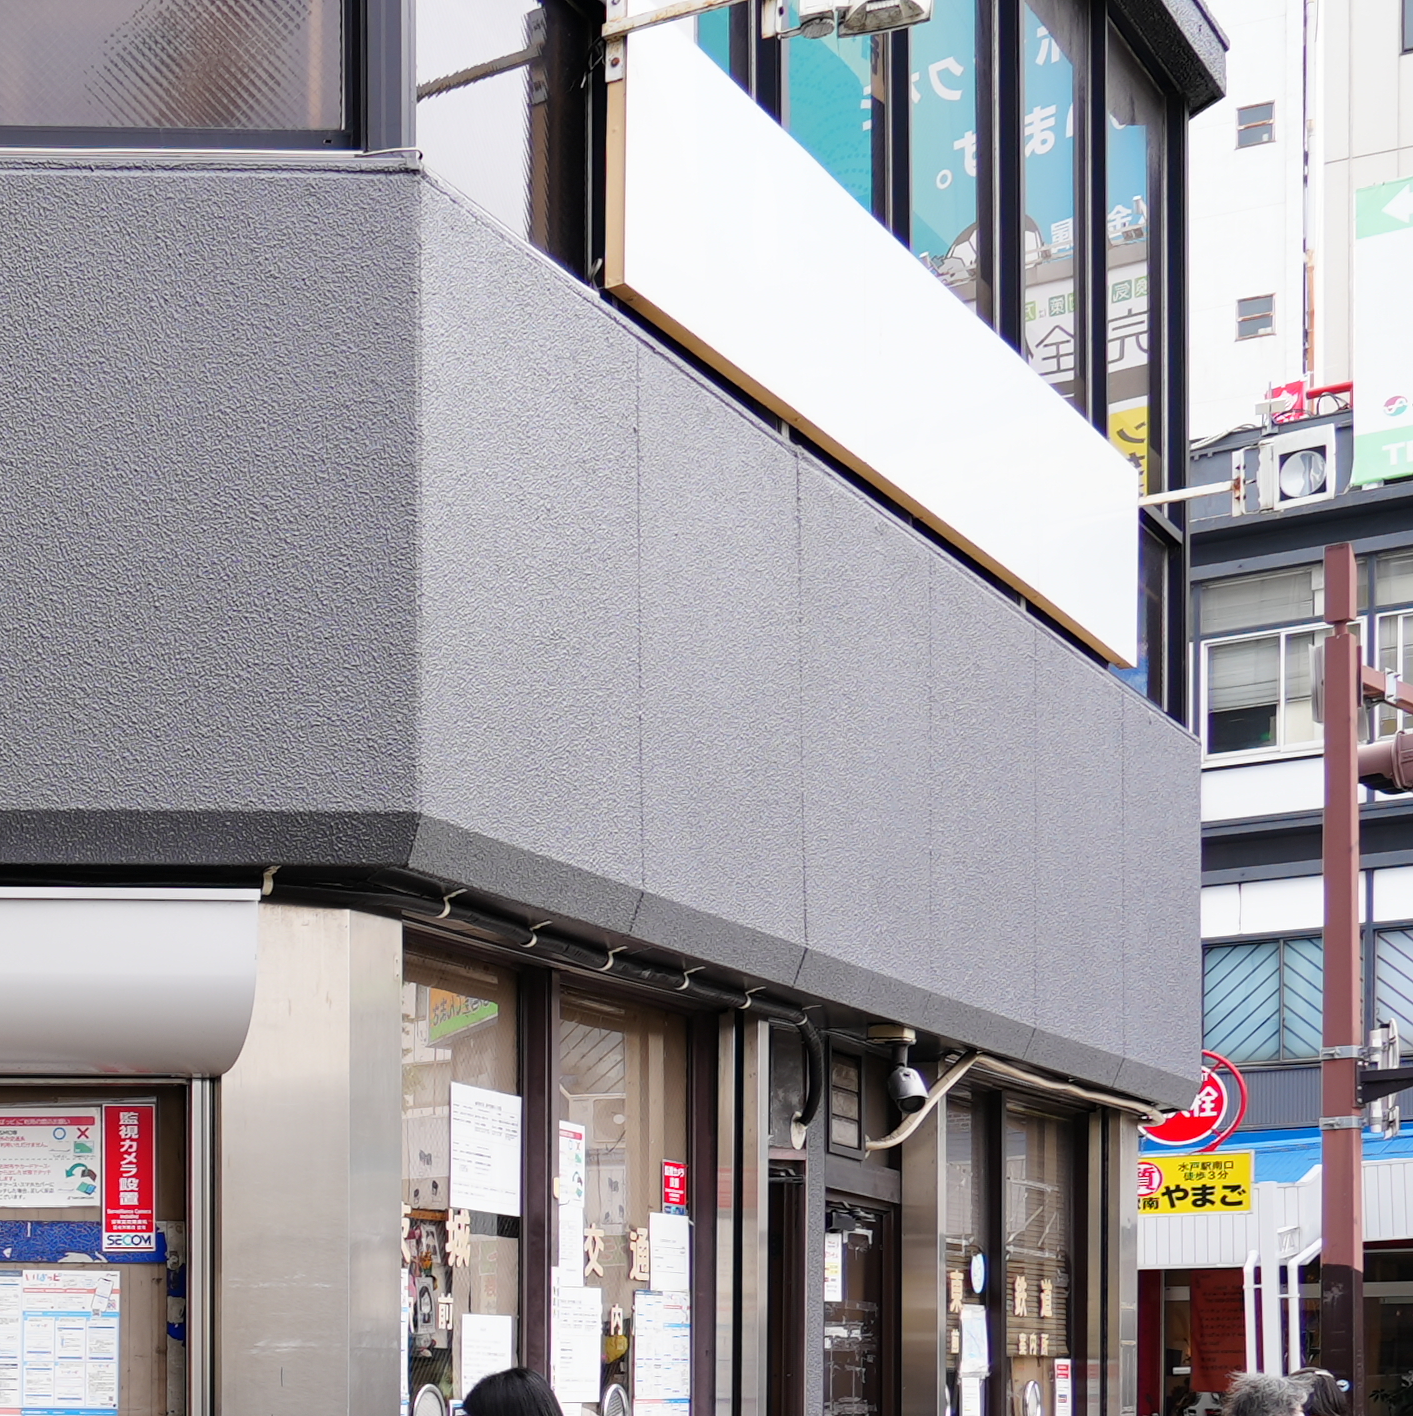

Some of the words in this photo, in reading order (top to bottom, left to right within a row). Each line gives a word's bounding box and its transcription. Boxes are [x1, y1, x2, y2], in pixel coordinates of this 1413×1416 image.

[118, 1111, 139, 1206] 監視カメラ設置
[1178, 1161, 1234, 1172] 水戸駅南口
[1161, 1183, 1247, 1209] やまご
[107, 1234, 152, 1246] SECOM
